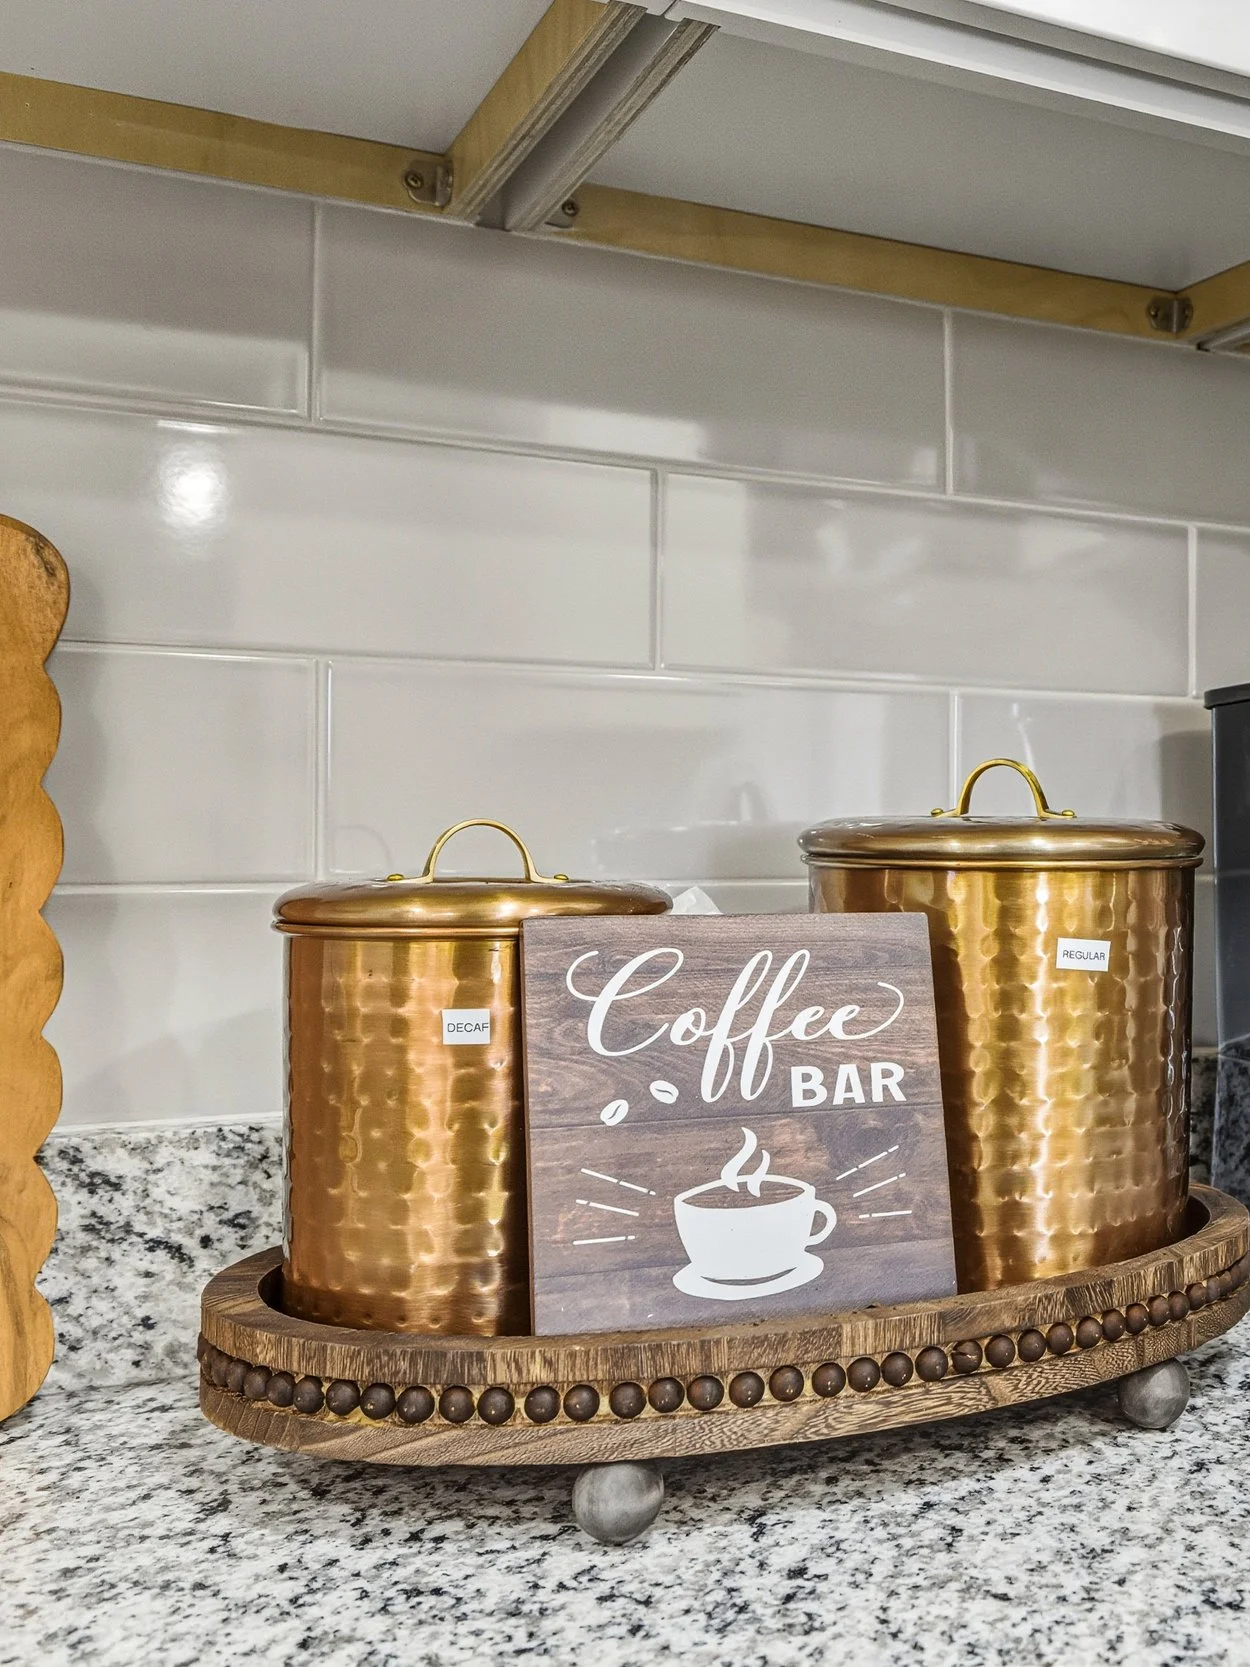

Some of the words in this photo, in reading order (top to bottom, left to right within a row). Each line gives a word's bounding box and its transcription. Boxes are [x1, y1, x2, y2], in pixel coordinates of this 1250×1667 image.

[1062, 949, 1106, 961] REGULAR
[447, 1022, 489, 1033] DECAF
[566, 947, 904, 1103] Coffee
[791, 1061, 907, 1108] BAR
